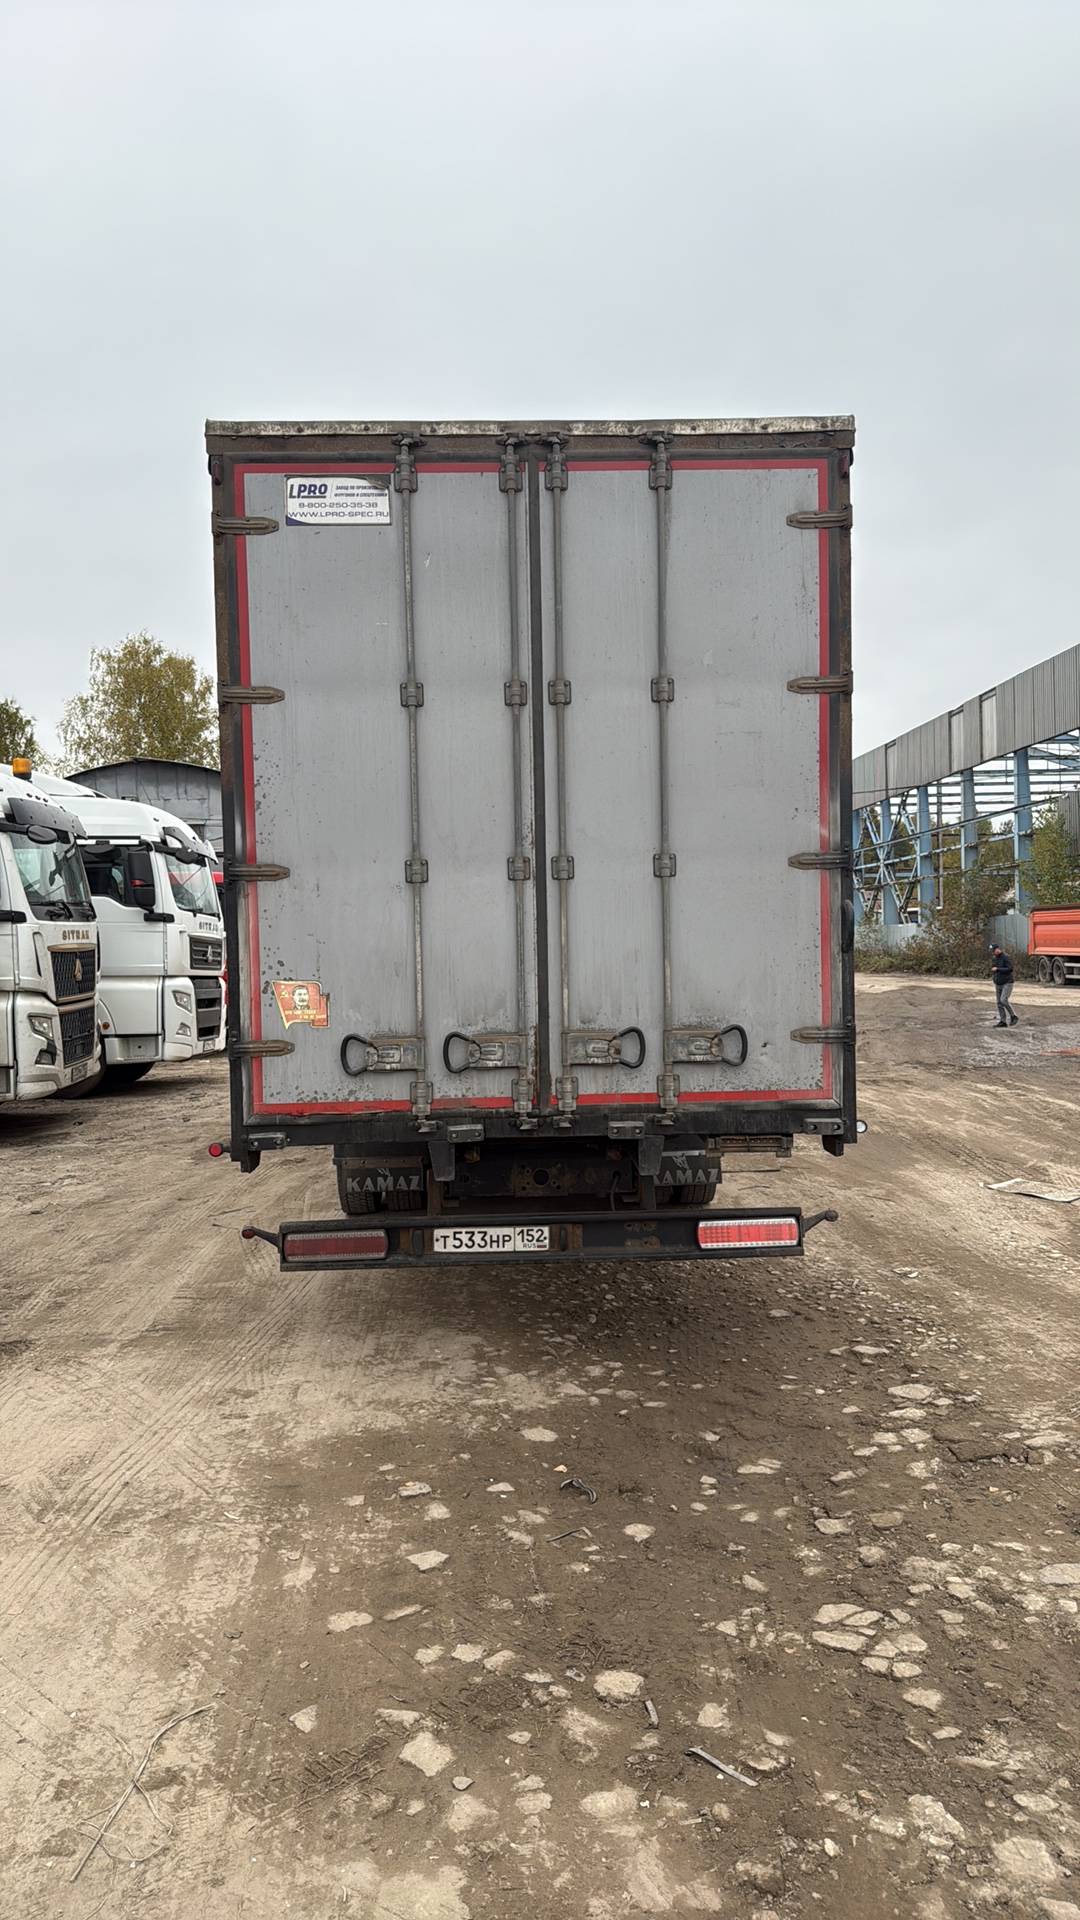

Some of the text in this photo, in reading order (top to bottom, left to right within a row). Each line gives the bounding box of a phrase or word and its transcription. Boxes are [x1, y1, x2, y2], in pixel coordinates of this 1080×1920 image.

[288, 483, 328, 499] LPRO
[346, 1175, 420, 1192] KAMAZ
[517, 1228, 545, 1243] 152
